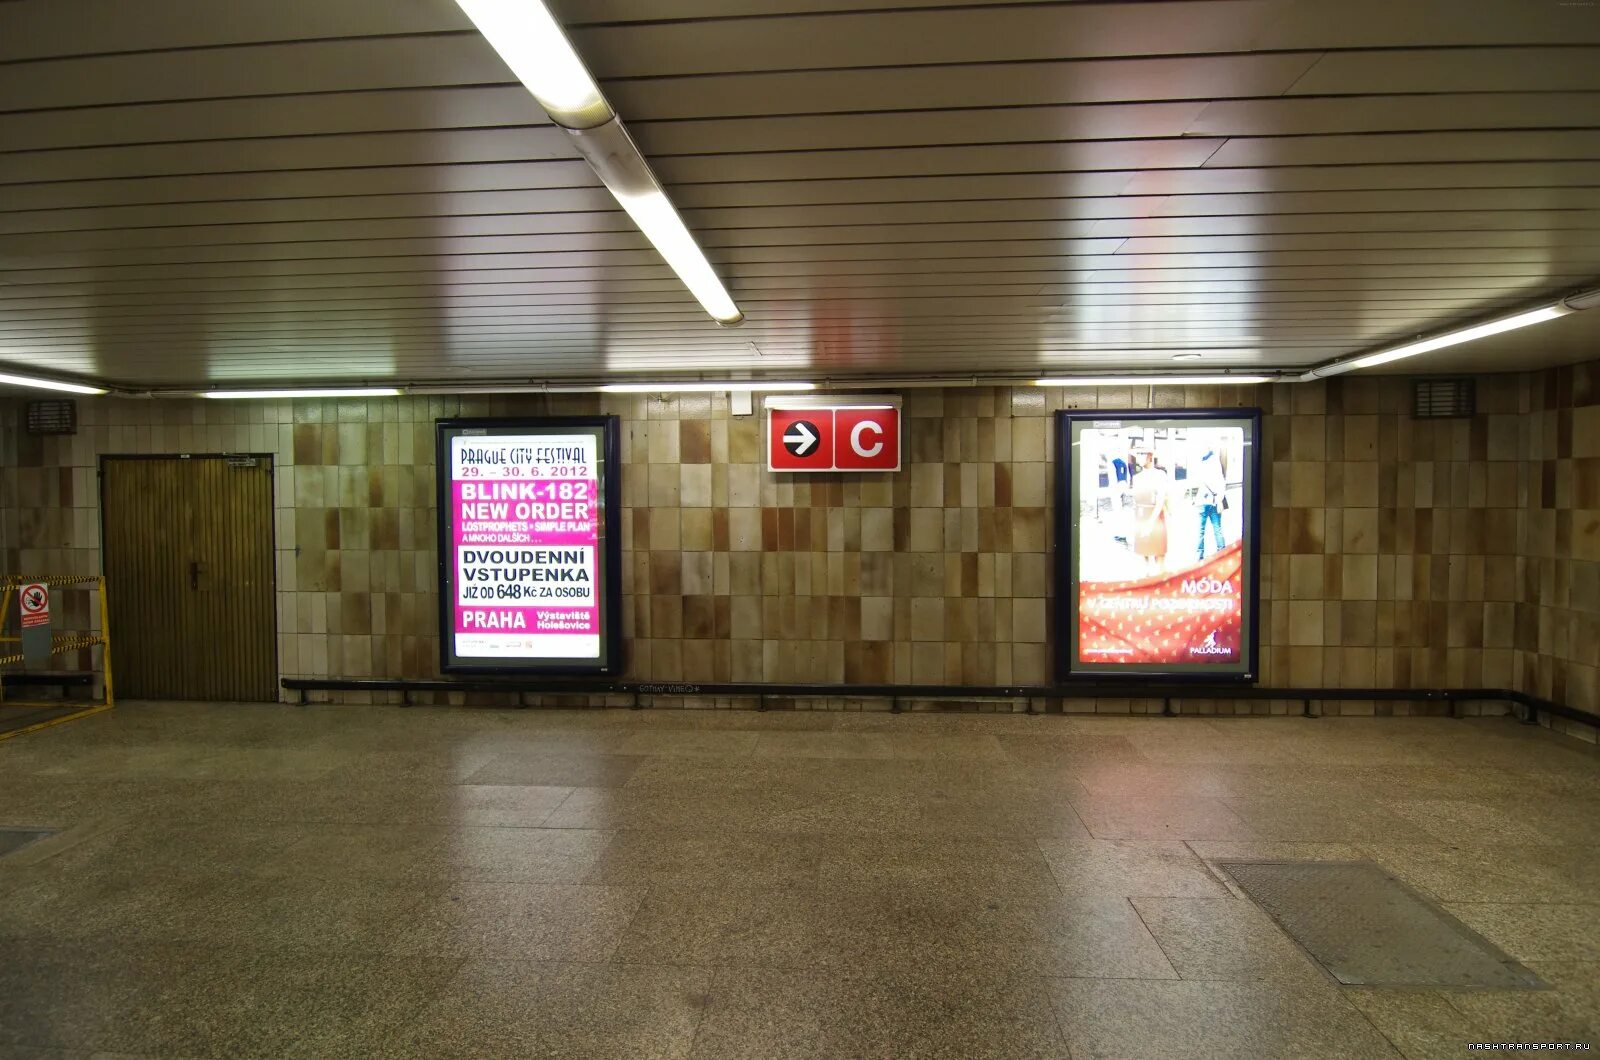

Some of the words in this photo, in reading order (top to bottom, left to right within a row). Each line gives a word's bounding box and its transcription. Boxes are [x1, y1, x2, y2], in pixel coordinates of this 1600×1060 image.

[850, 420, 883, 458] C
[461, 448, 506, 465] PRAGUE
[510, 447, 532, 464] CITY
[536, 447, 587, 464] FESTIVAL
[461, 466, 484, 477] 29.
[502, 466, 525, 477] 30.
[531, 466, 544, 477] 6.
[551, 466, 587, 476] 2012
[461, 482, 588, 500] BLINK-182
[462, 503, 508, 520] NEW
[515, 502, 589, 520] ORDER
[462, 522, 528, 532] LOSTPROPHETS
[535, 522, 566, 532] SIMPLE
[567, 522, 590, 532] PLAN
[462, 534, 469, 543] A
[469, 534, 496, 543] MNOHO
[463, 547, 585, 564] DVOUDENNÍ
[463, 568, 589, 582] VSTUPENKA
[463, 584, 478, 599] JIŽ
[480, 586, 494, 599] OD
[497, 584, 521, 599] 648
[523, 585, 537, 598] Kč
[539, 587, 552, 598] ZA
[555, 586, 590, 598] OSOBU
[1181, 578, 1233, 594] MÓDA
[463, 611, 526, 629] PRAHA
[537, 611, 590, 621] Výstaviště
[537, 620, 590, 630] Holešovice
